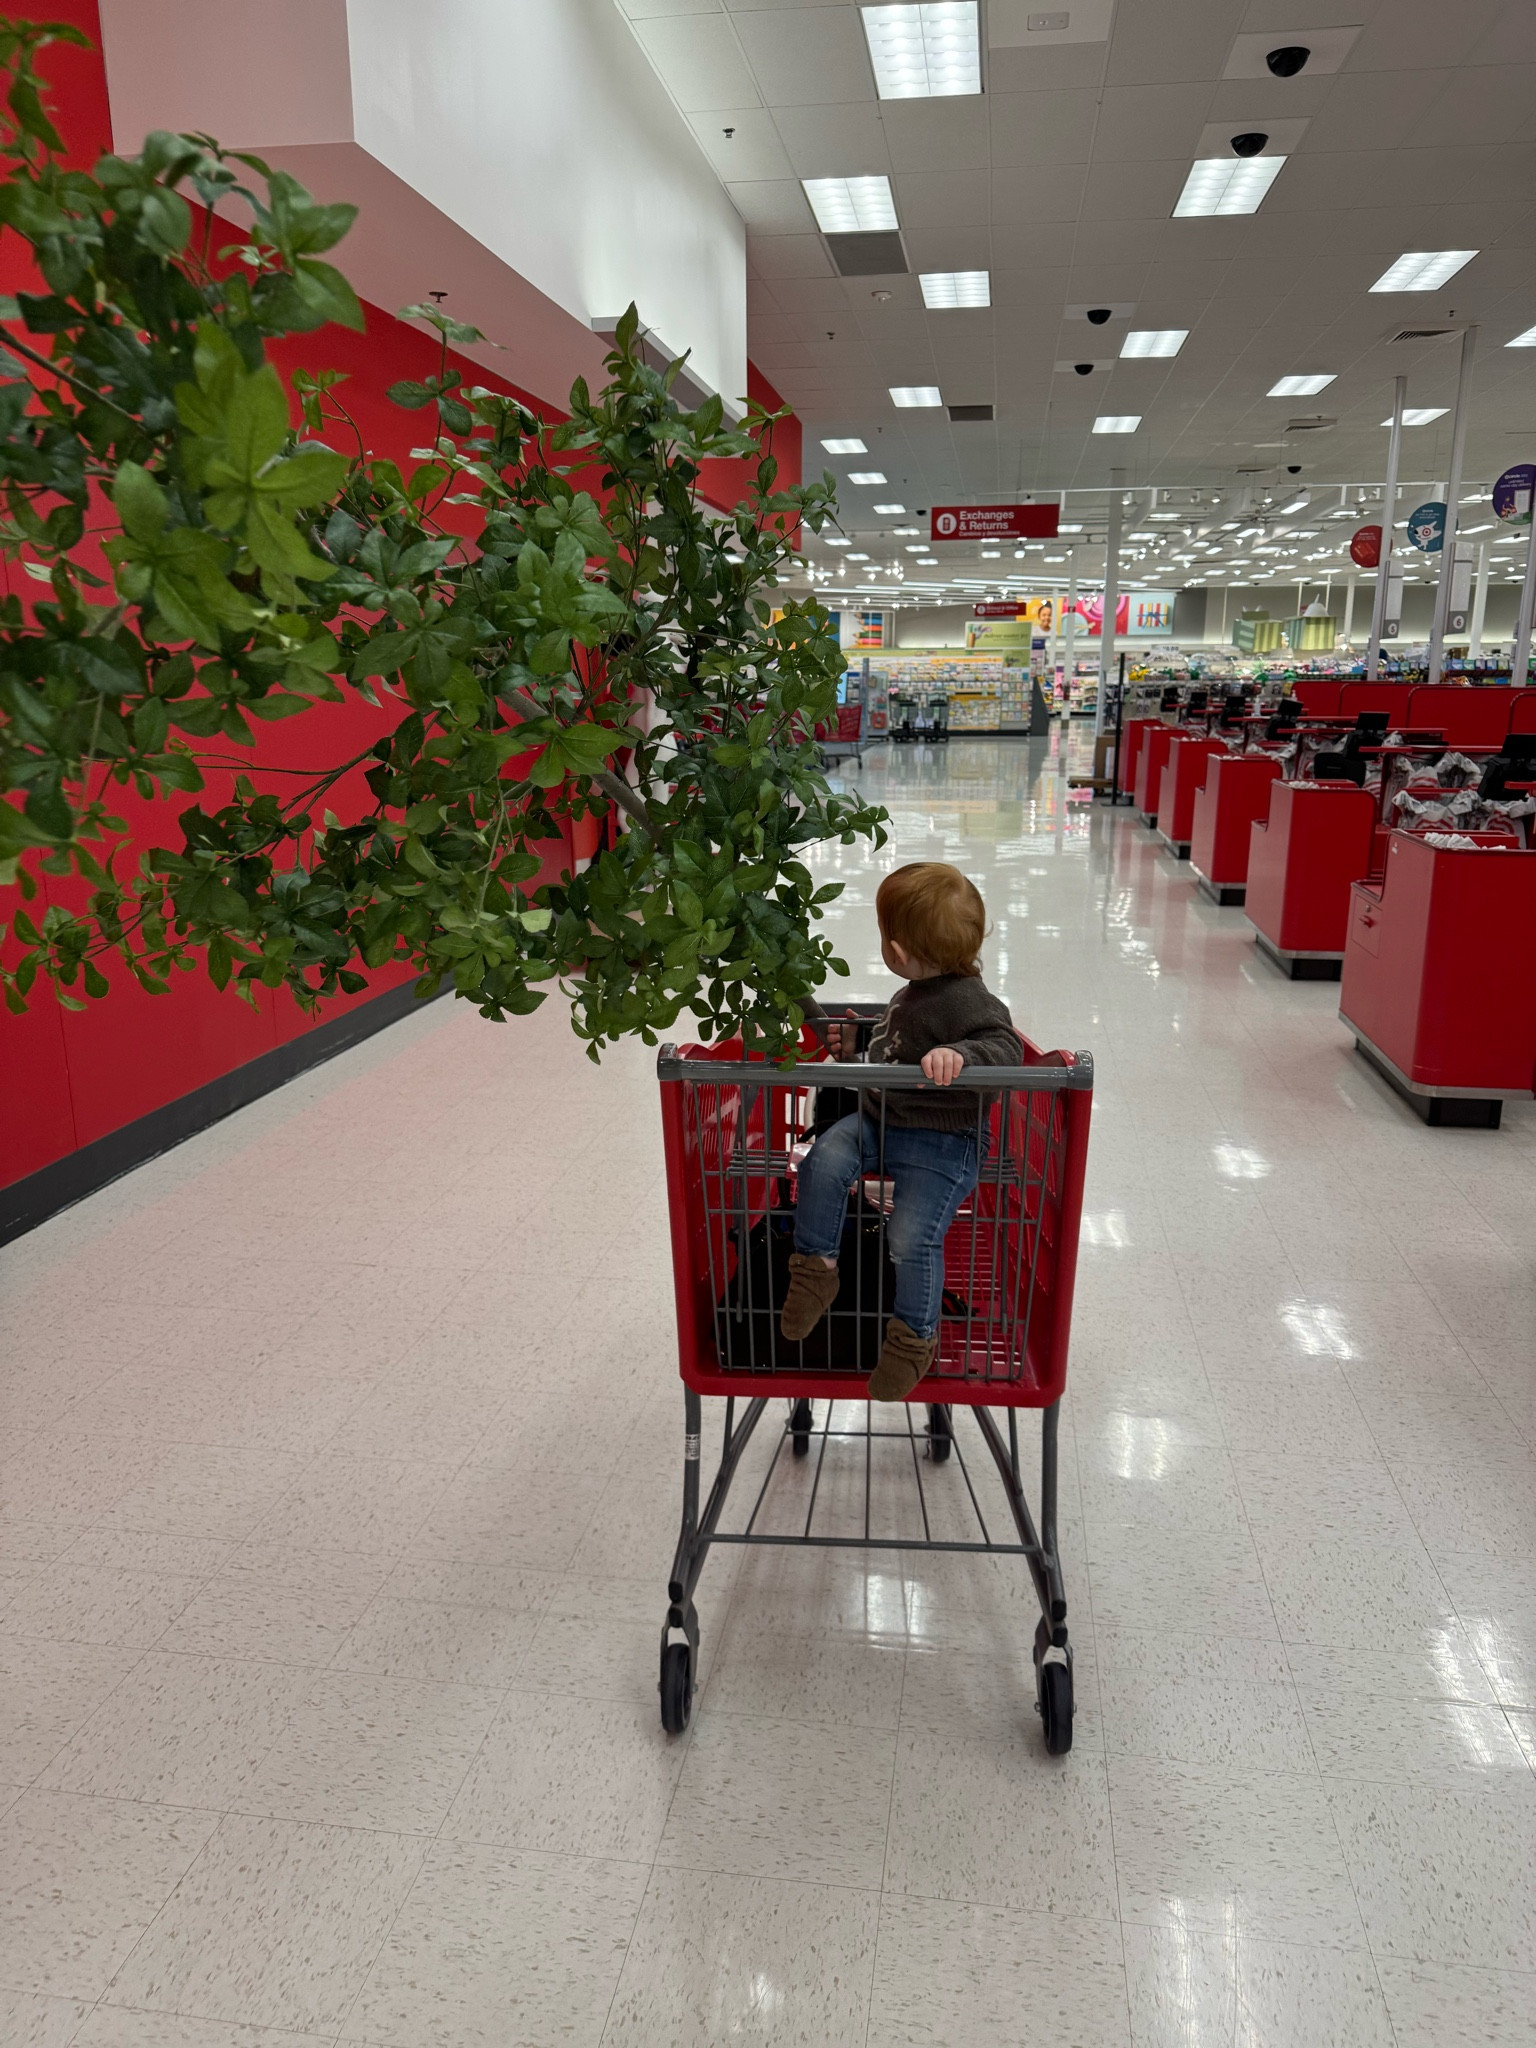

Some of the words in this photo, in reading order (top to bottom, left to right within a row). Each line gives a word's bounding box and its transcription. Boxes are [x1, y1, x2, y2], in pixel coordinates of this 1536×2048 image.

[960, 510, 1014, 520] Exchanges
[960, 522, 966, 530] &
[970, 521, 1008, 530] Returns
[1456, 618, 1462, 627] 6
